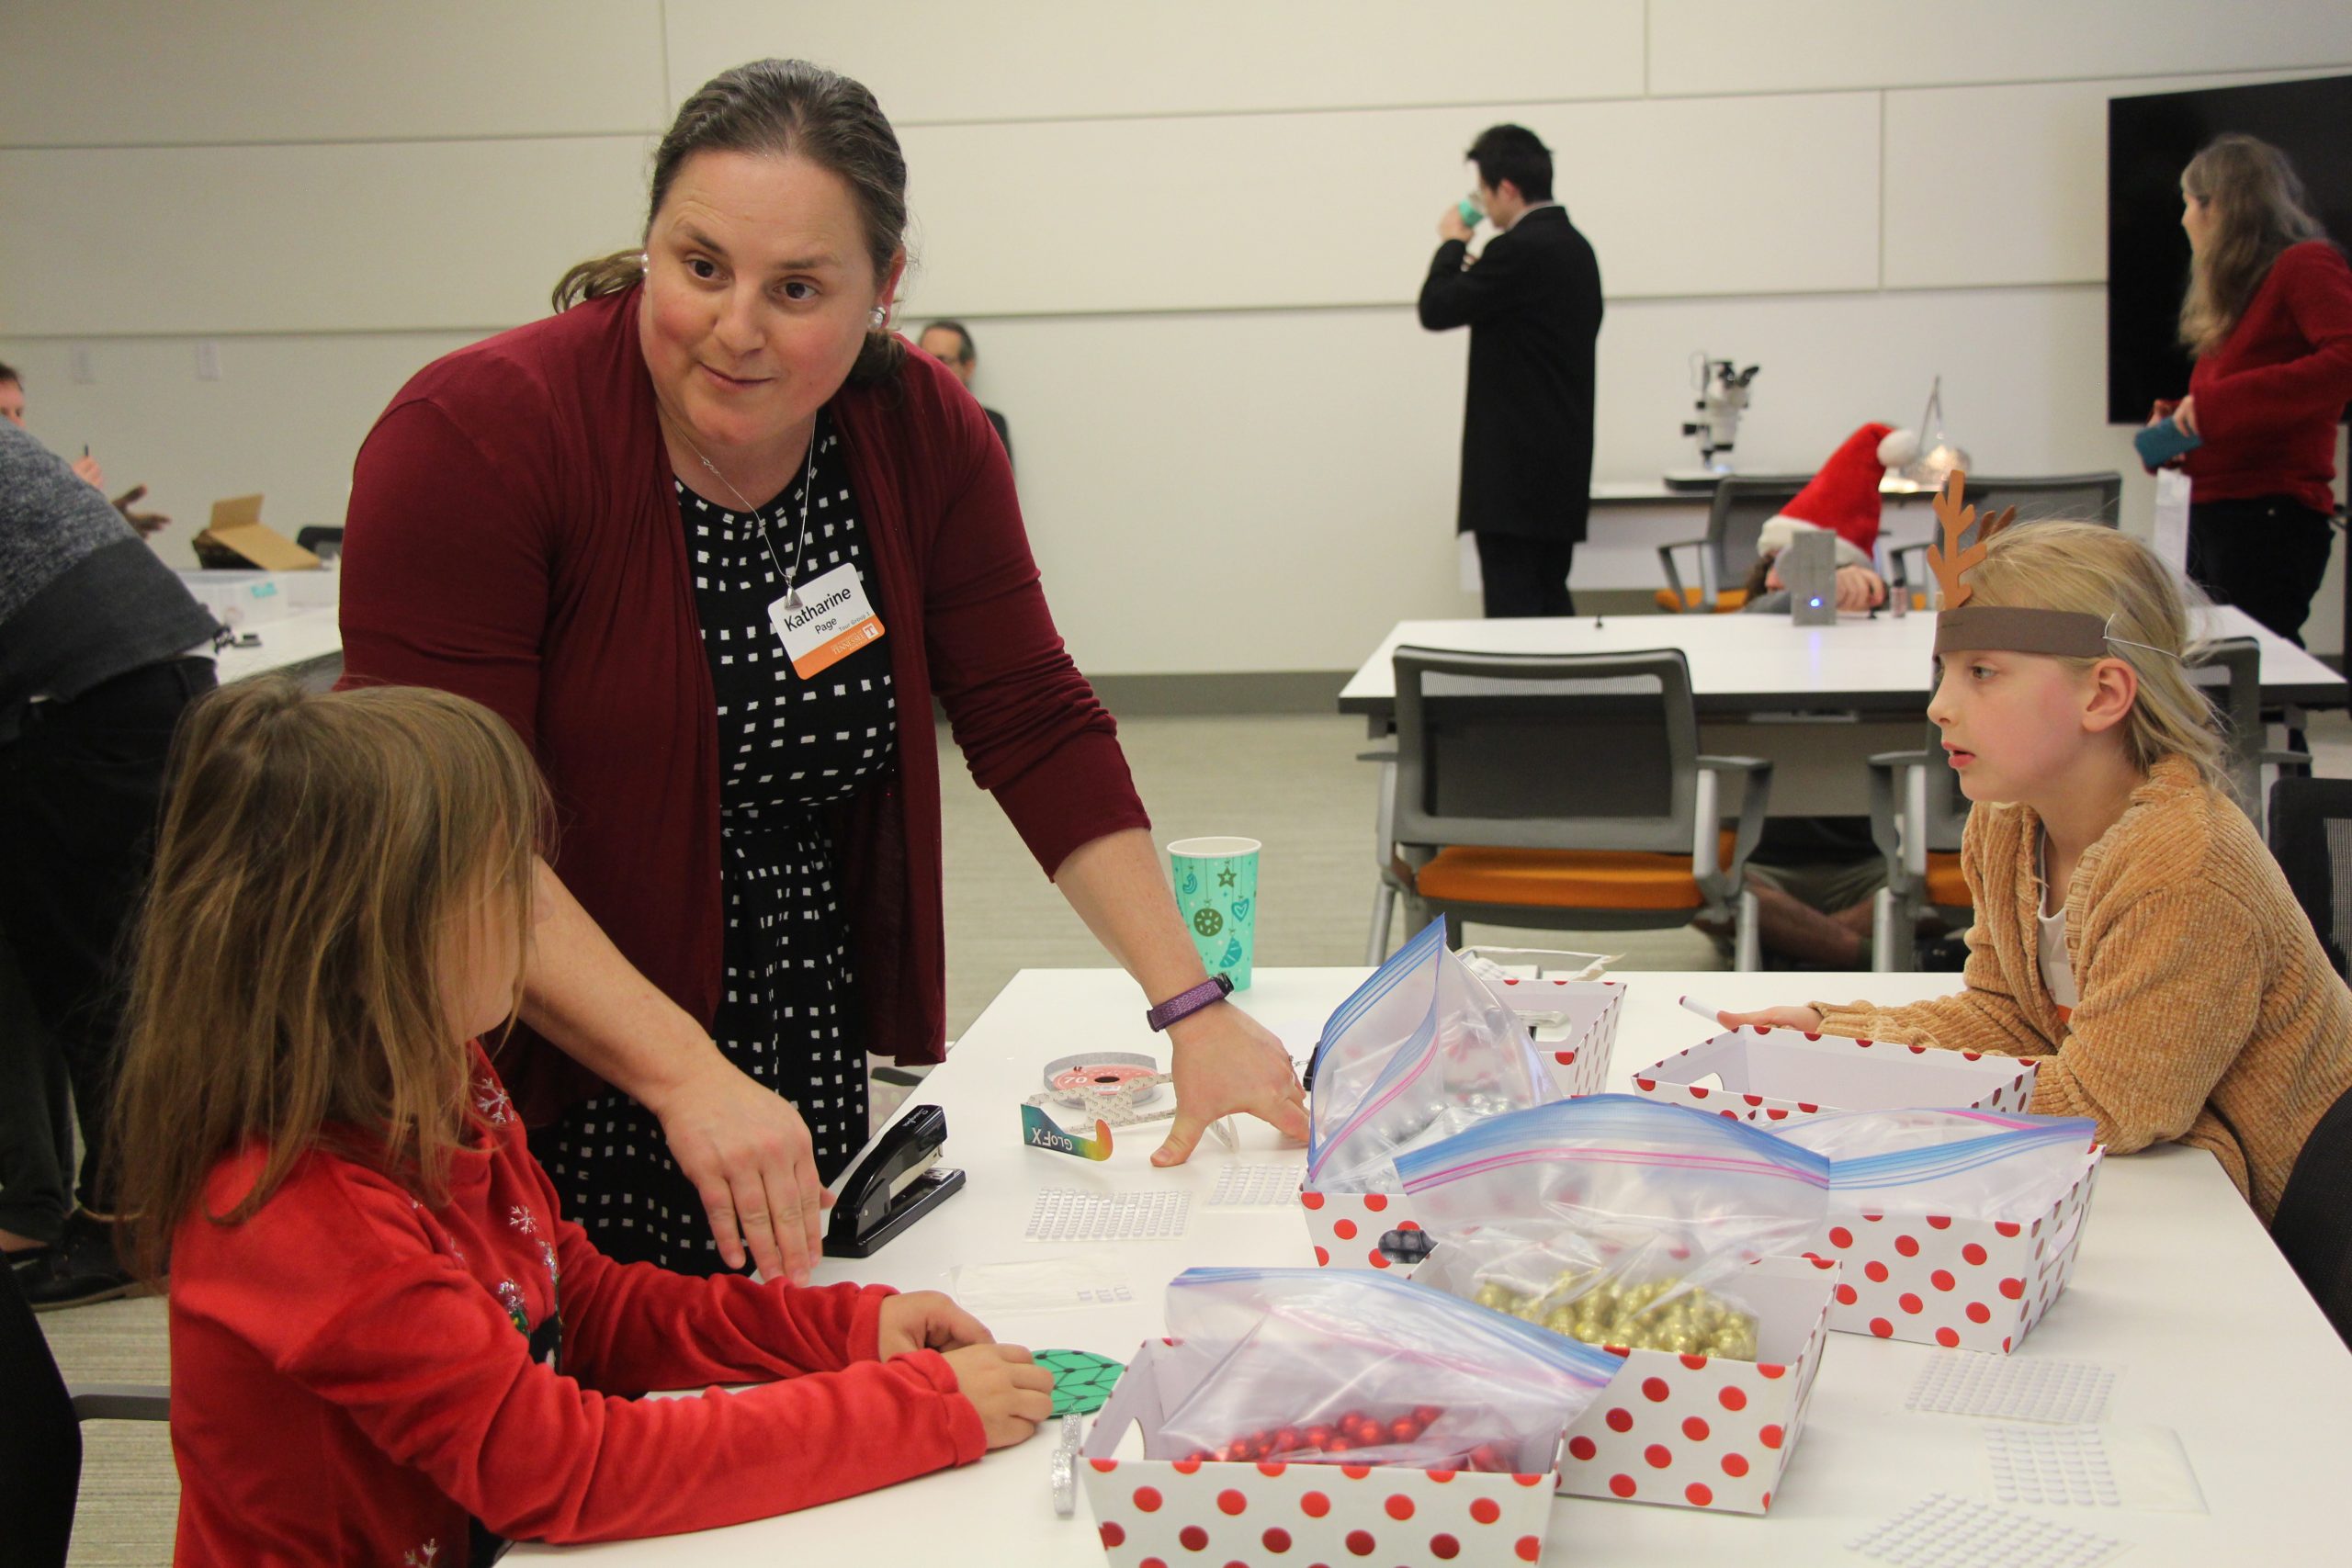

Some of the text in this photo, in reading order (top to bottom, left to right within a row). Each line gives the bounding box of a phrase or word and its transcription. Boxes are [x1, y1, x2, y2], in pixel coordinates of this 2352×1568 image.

[784, 588, 852, 632] Katharine
[815, 617, 838, 634] Page
[865, 625, 875, 637] T
[1064, 1076, 1088, 1084] 70
